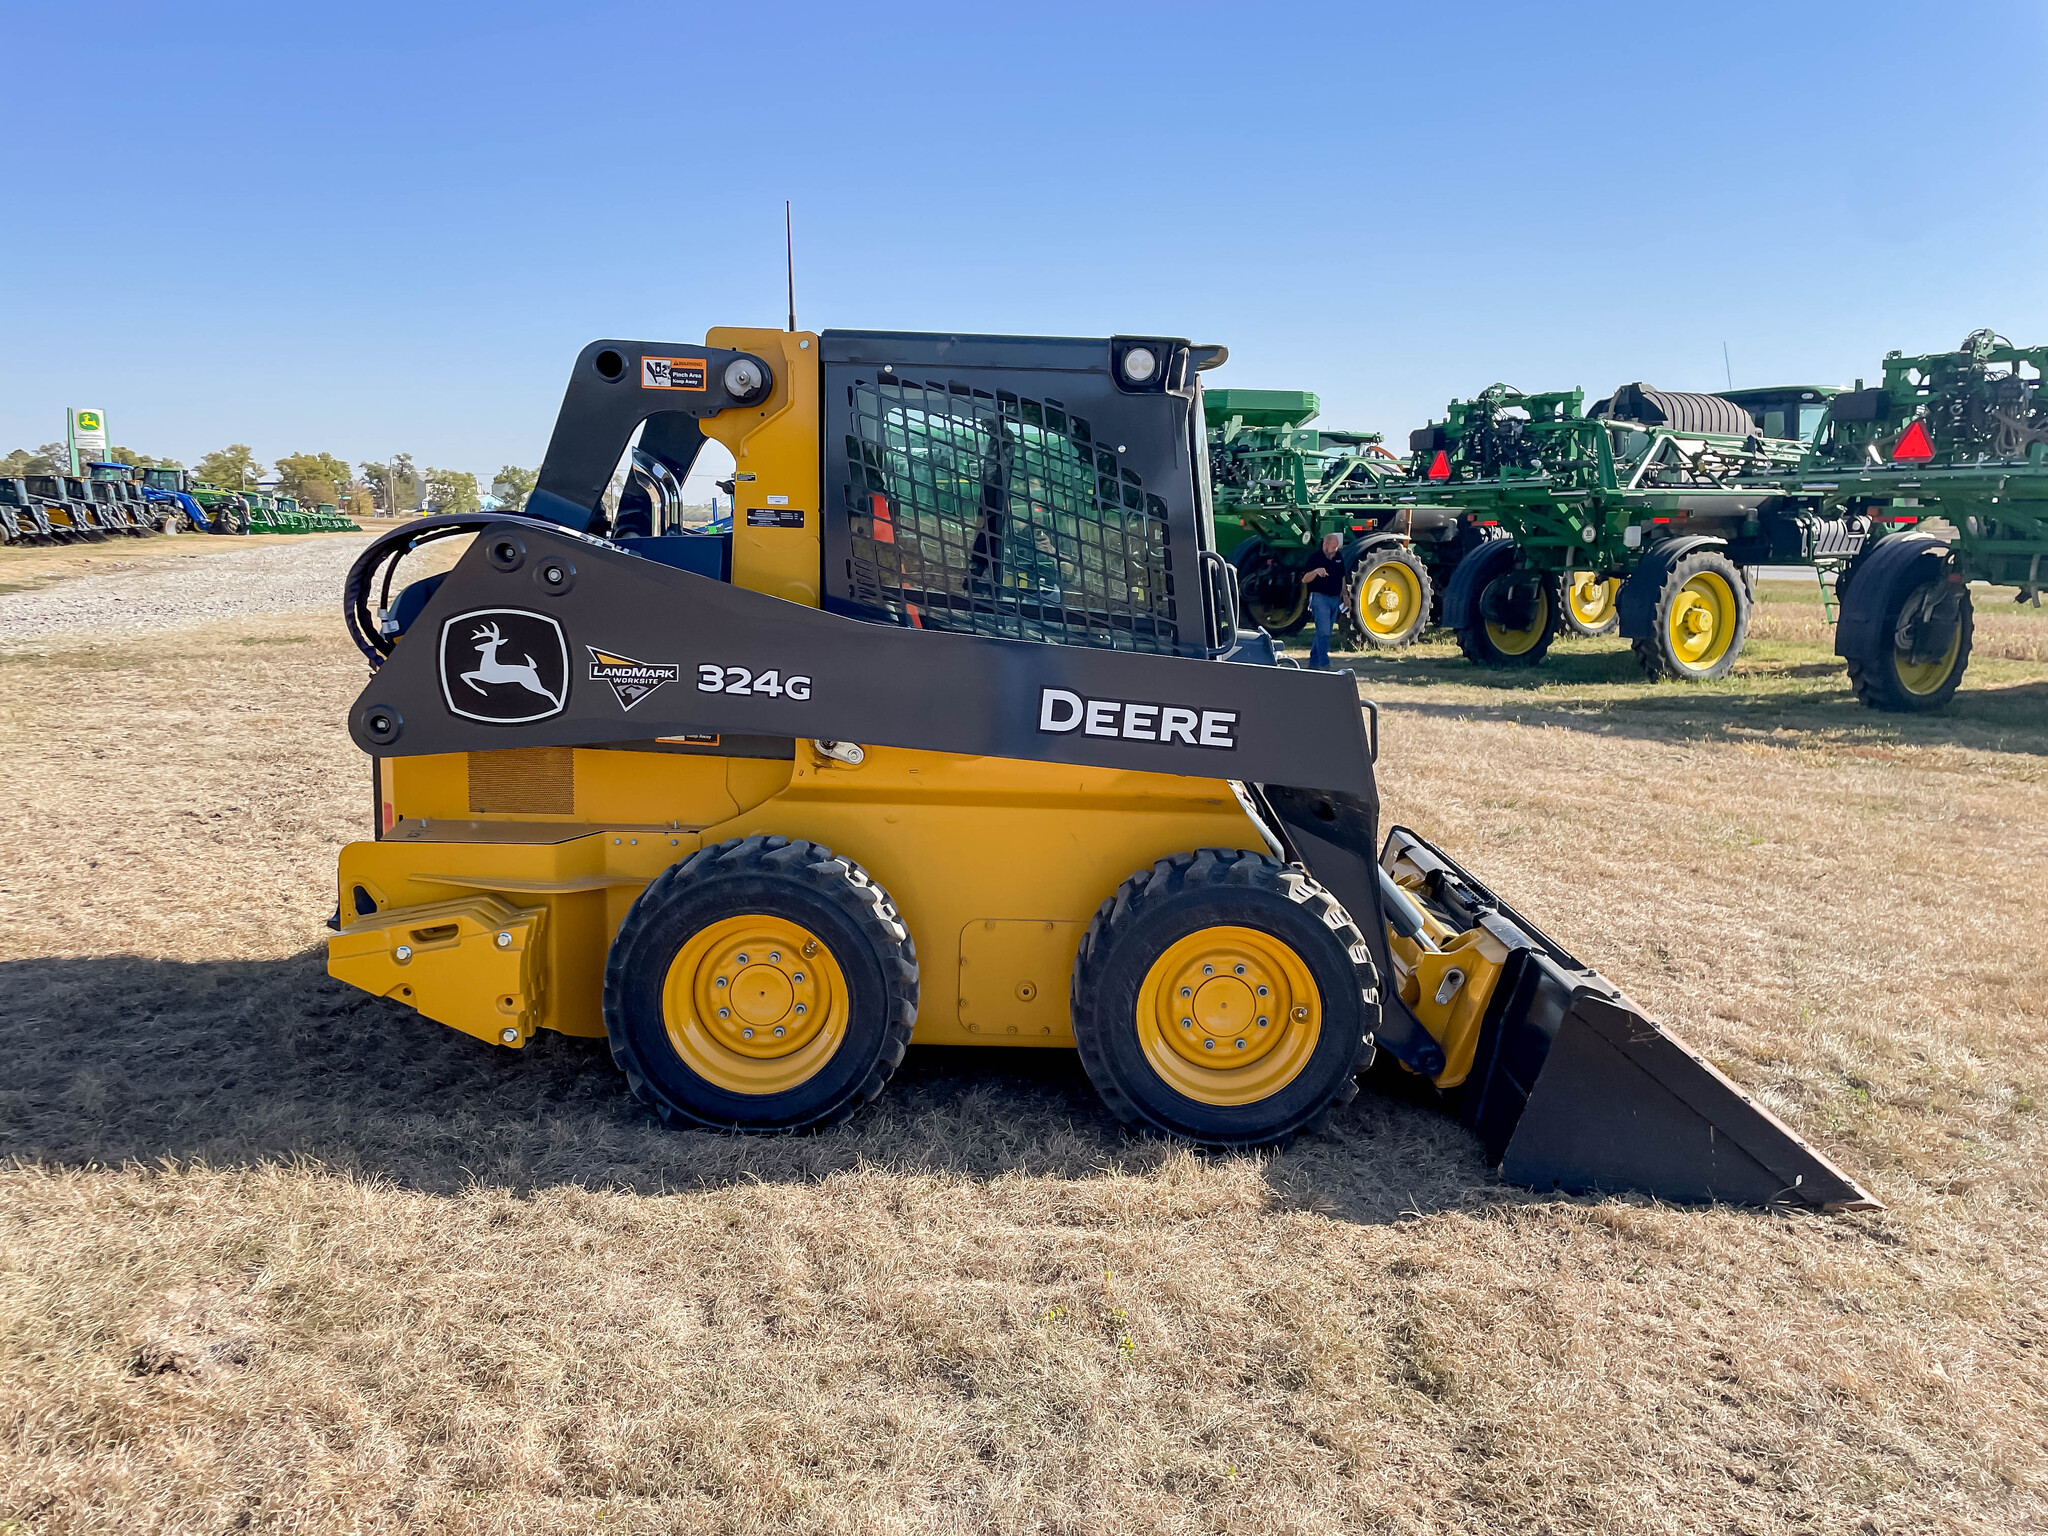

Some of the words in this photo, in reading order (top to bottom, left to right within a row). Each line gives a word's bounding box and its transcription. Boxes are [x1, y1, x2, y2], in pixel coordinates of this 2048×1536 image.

[593, 666, 675, 679] LANDMARK
[613, 677, 659, 685] WORKSITE
[697, 664, 811, 700] 324G
[1039, 688, 1236, 748] DEERE
